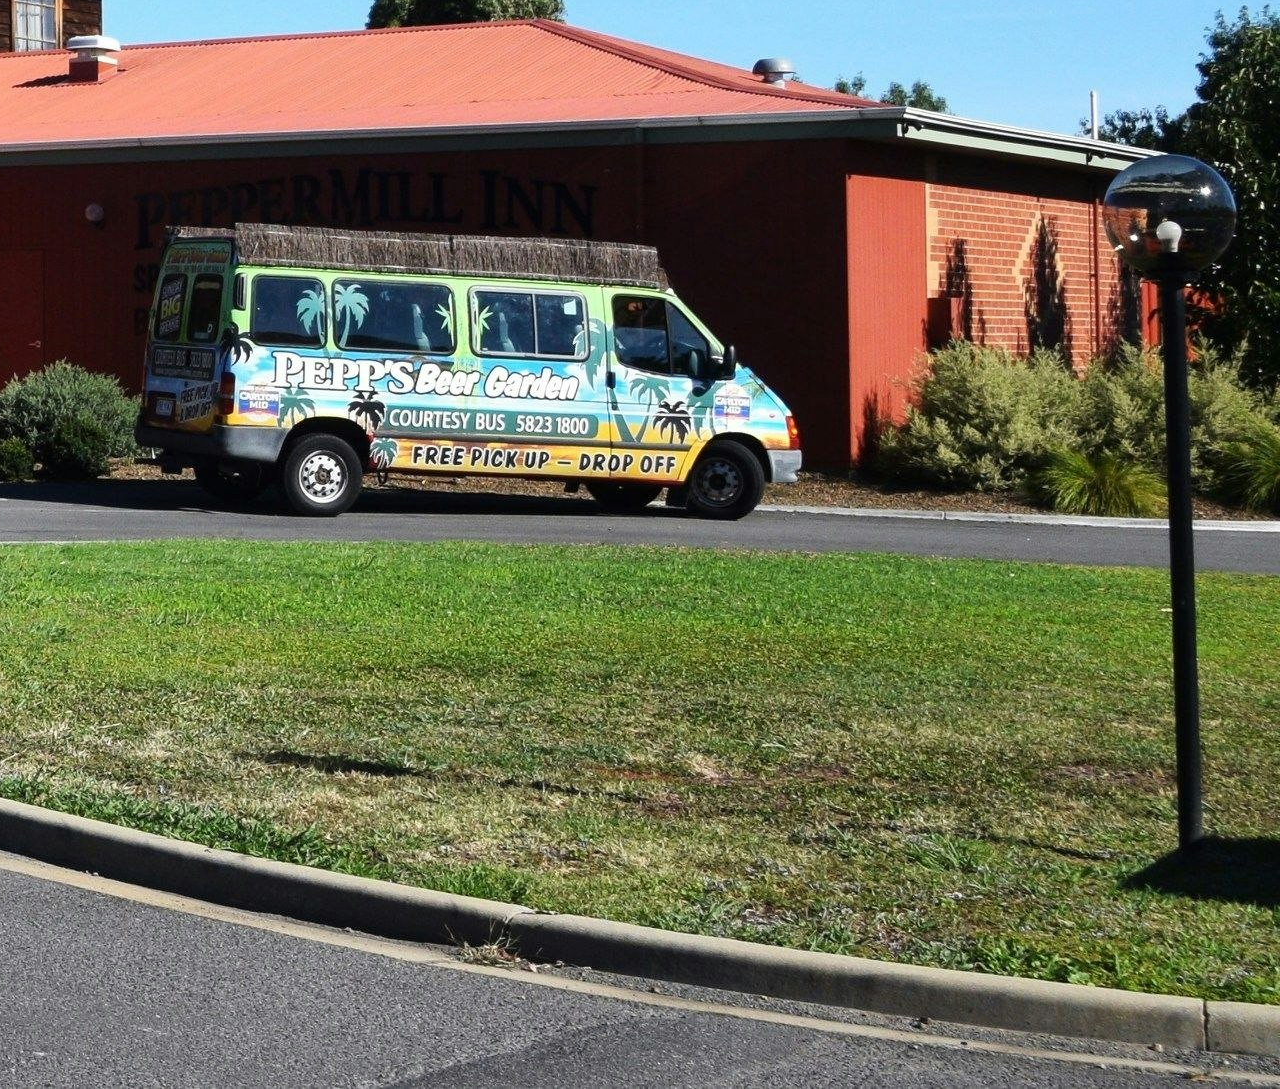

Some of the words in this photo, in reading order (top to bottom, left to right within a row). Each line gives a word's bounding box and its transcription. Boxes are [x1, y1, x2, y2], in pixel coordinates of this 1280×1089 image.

[133, 168, 463, 249] PEPPERMILL
[480, 170, 597, 238] INN
[161, 294, 181, 319] BIG
[271, 350, 415, 395] PEPP'S
[415, 362, 480, 396] Beer
[484, 365, 579, 400] Garden
[239, 391, 279, 402] CARLTON
[249, 400, 268, 409] MID
[715, 396, 750, 407] CARLTON
[389, 408, 471, 429] COURTESY
[475, 413, 506, 431] BUS
[516, 415, 551, 434] 5823
[556, 416, 589, 435] 1800
[723, 405, 741, 415] MID
[412, 446, 467, 466] FREE
[471, 448, 520, 469] PICK
[523, 451, 551, 469] UP
[579, 454, 634, 472] DROP
[639, 456, 677, 474] OFF
